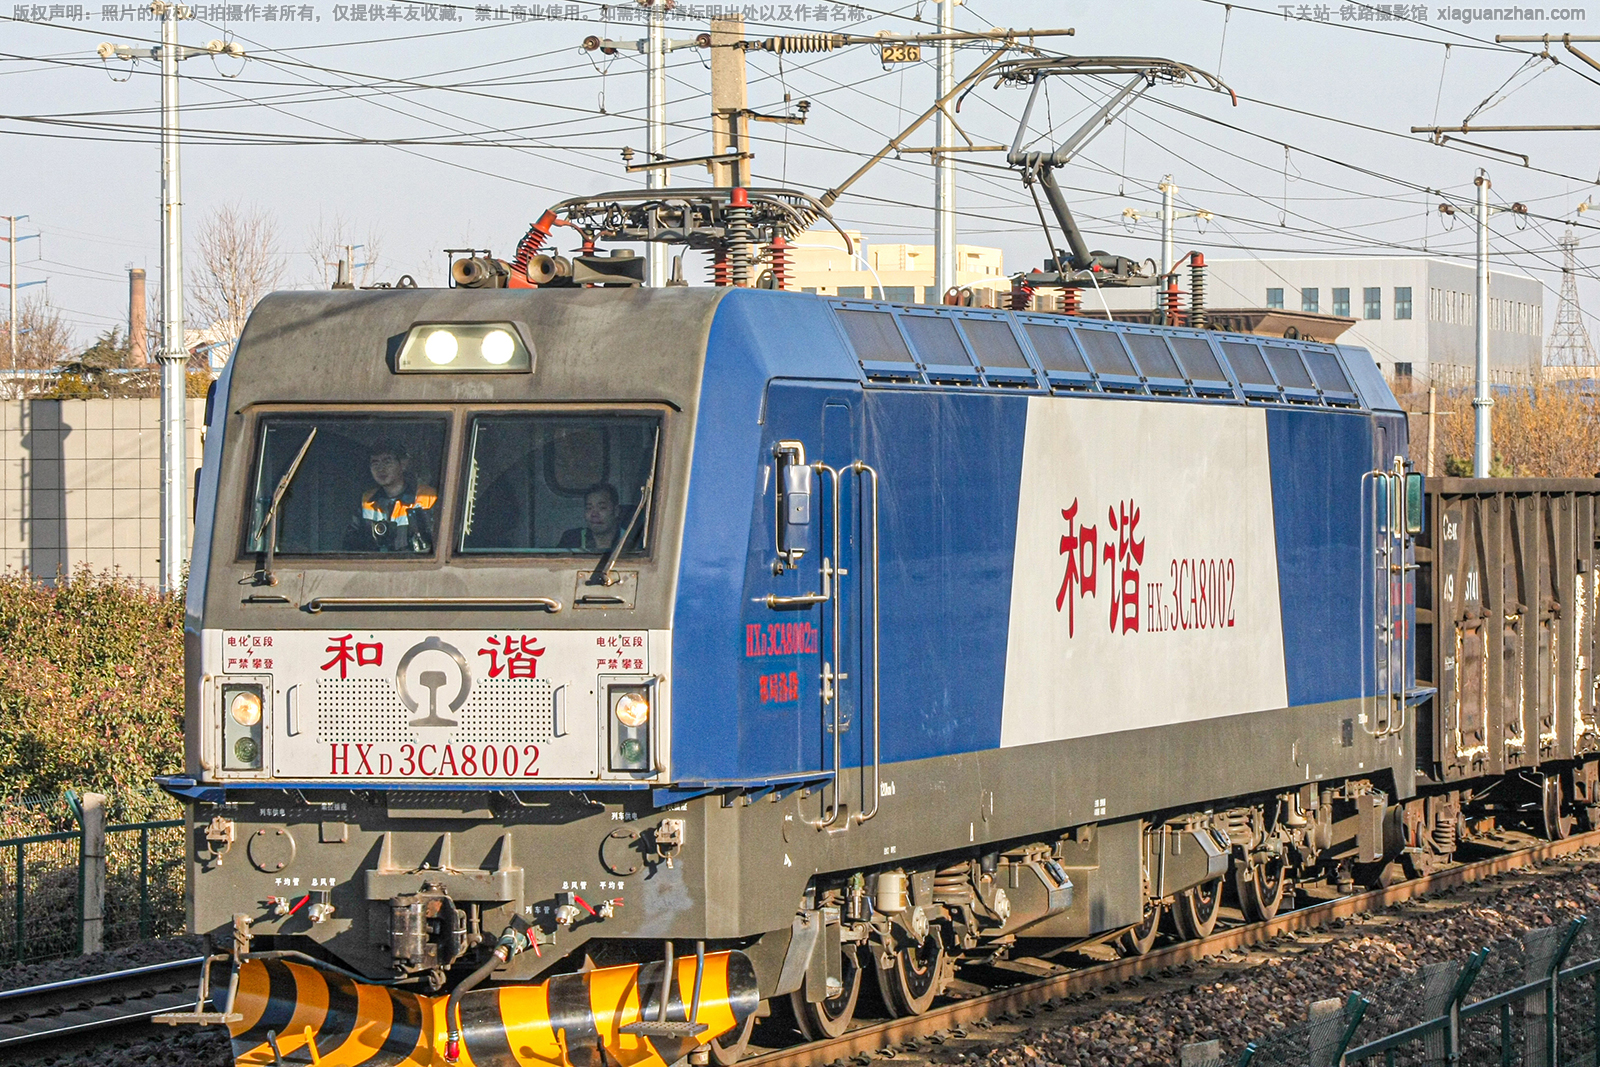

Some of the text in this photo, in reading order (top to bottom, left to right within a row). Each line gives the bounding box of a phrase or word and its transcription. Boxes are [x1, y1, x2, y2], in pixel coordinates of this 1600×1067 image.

[884, 47, 918, 61] 236
[1055, 497, 1146, 639] 和谐
[320, 633, 546, 680] 和 谐
[227, 658, 273, 670] 严禁攀登
[596, 658, 643, 670] 严禁攀登
[275, 878, 336, 886] 平均管 总风管
[562, 881, 625, 890] 总风管 平均管
